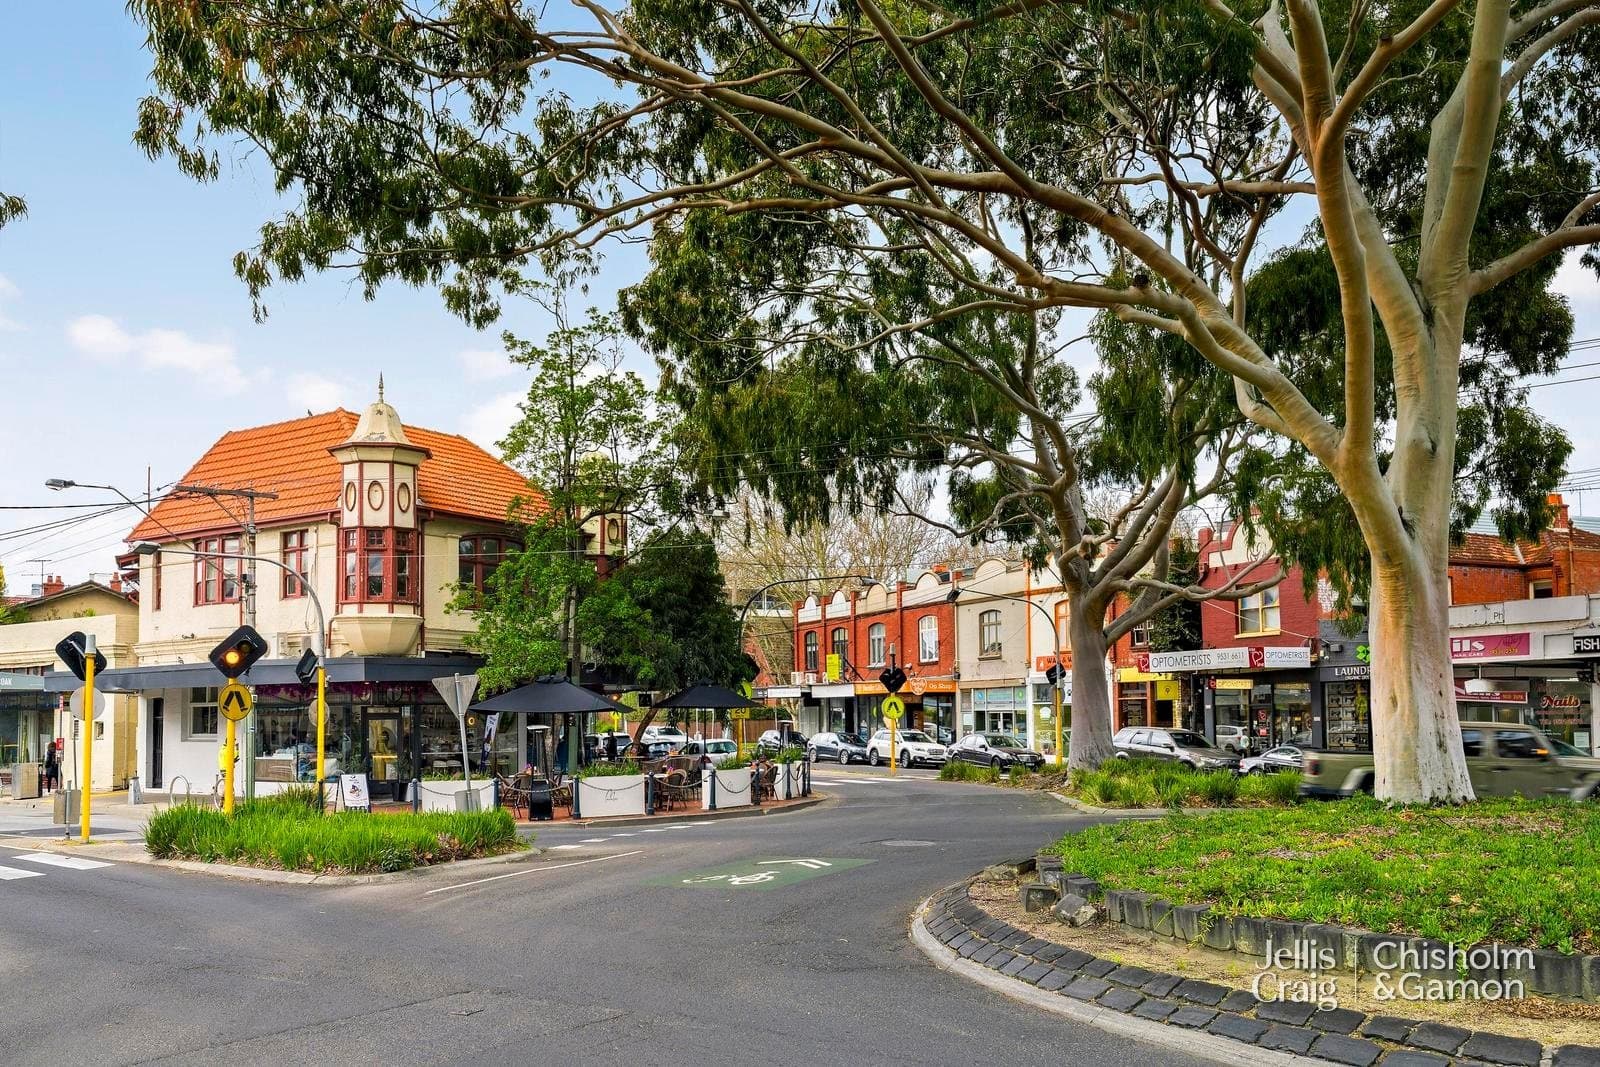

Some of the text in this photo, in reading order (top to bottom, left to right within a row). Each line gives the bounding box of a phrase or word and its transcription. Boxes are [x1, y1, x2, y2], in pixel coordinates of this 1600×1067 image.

[1452, 639, 1486, 653] ils
[1574, 638, 1600, 651] FISH
[1151, 653, 1212, 669] OPTOMETRISTS
[1265, 651, 1309, 660] OPTOMETRISTS
[1540, 694, 1581, 708] Nails
